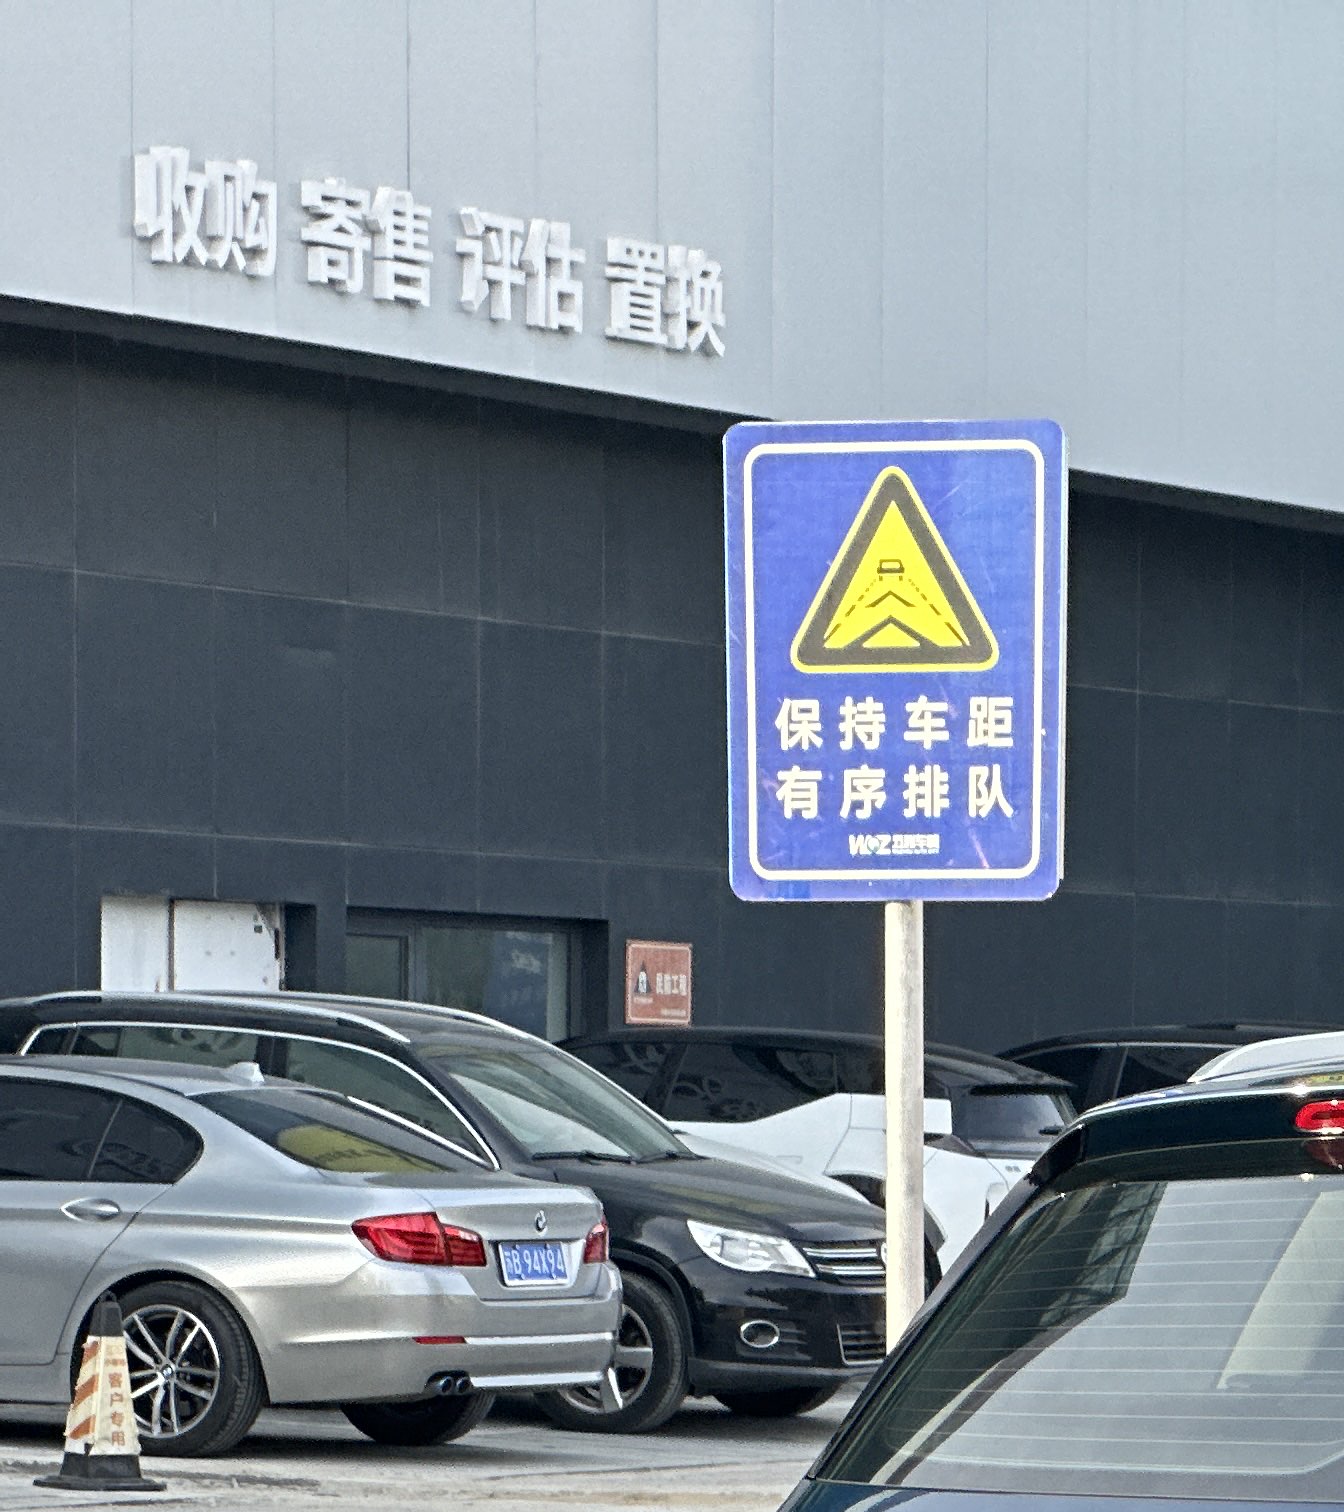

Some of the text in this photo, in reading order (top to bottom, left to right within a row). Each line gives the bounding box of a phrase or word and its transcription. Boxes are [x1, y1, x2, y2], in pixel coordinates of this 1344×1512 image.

[134, 146, 725, 357] 收购 寄售 评估 置换
[775, 695, 1014, 750] 保持车距
[776, 764, 1014, 819] 有序排队
